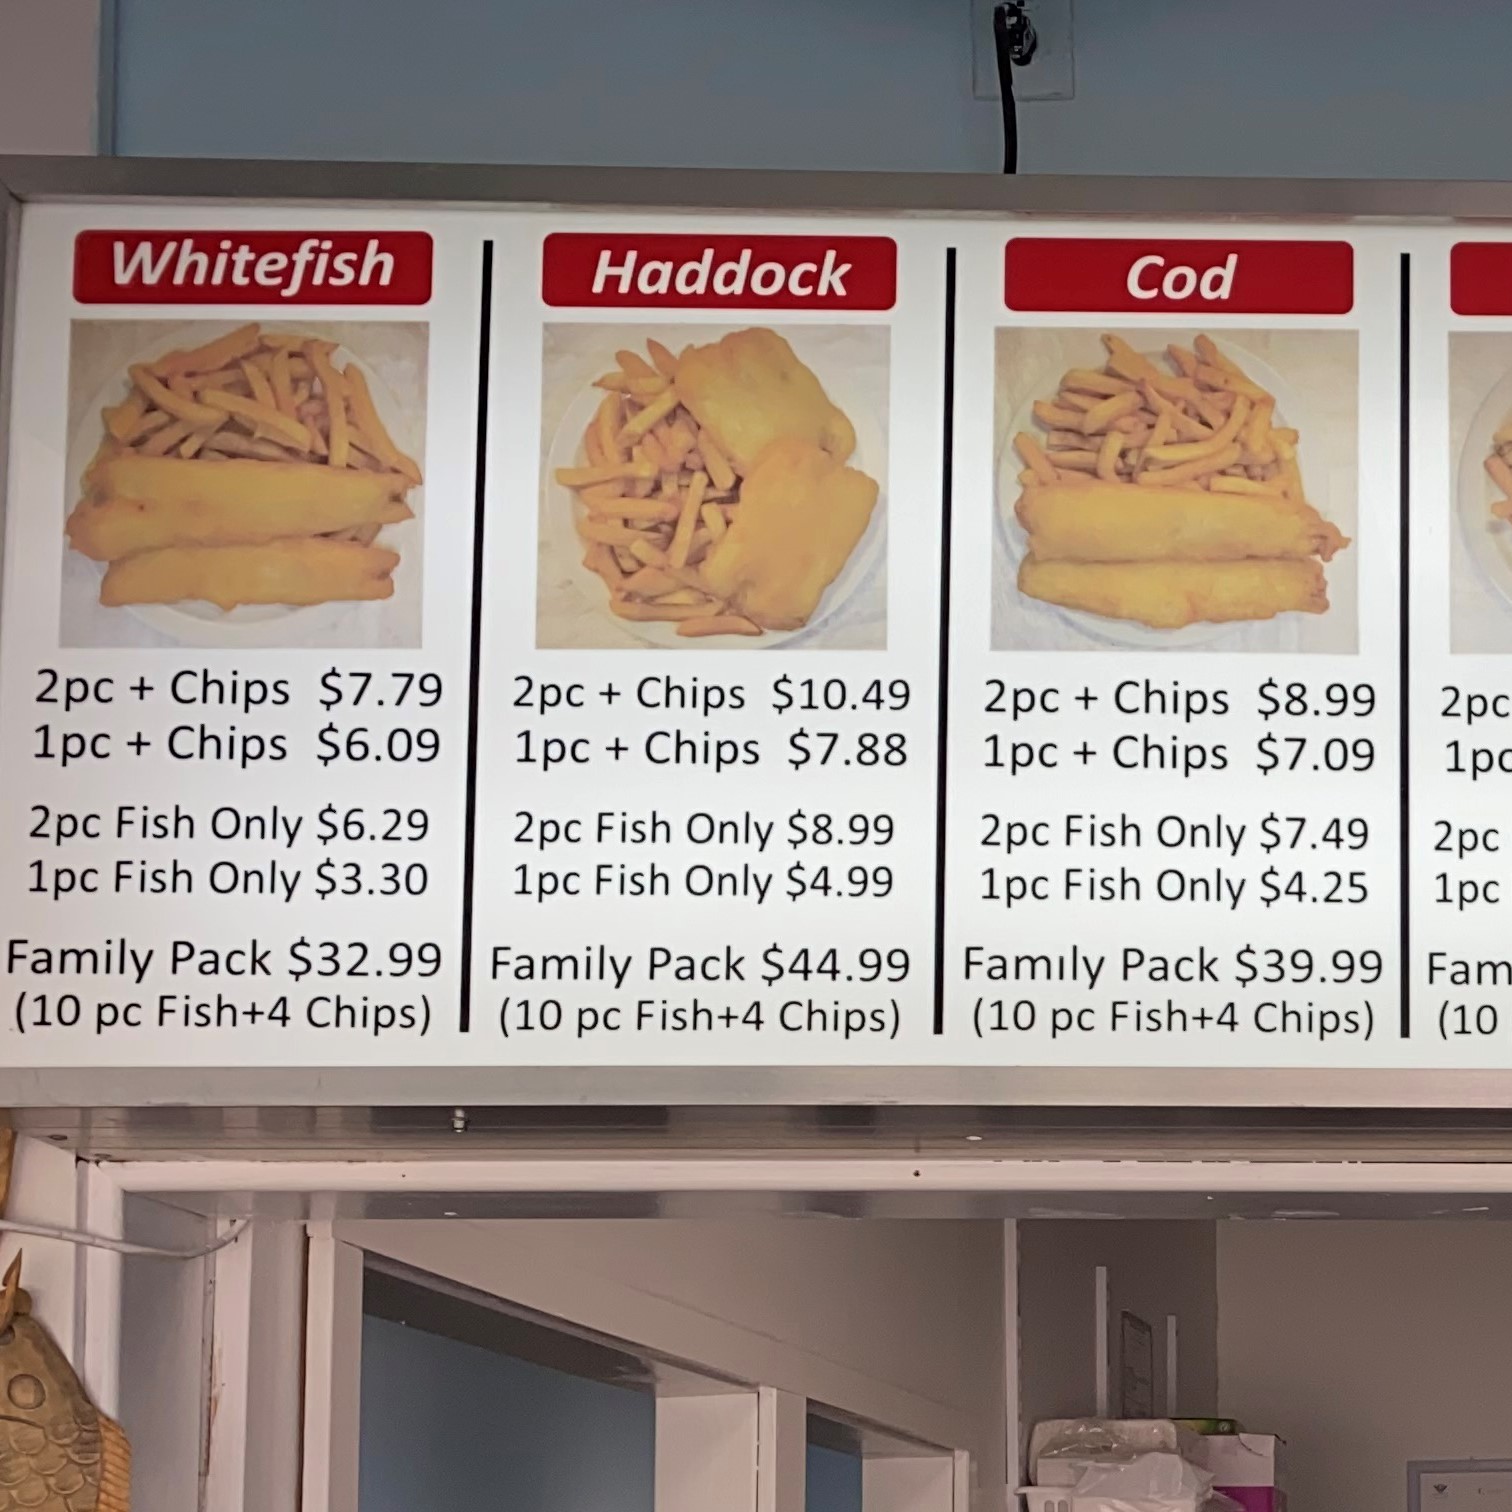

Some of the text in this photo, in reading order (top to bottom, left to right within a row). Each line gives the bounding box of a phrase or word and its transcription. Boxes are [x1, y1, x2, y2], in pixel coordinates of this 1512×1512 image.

[113, 238, 395, 297] Whitefish
[591, 248, 852, 297] Haddock
[1126, 253, 1238, 300] Cod
[35, 668, 114, 713] 2pc
[170, 668, 290, 714] Chips
[319, 666, 443, 712] $7.79
[513, 675, 585, 716] 2pc
[637, 675, 745, 717] Chips
[772, 673, 910, 715] $10.49
[980, 811, 1369, 857] 2pc Fish Only $7.49
[7, 935, 442, 984] Family Pack $32.99
